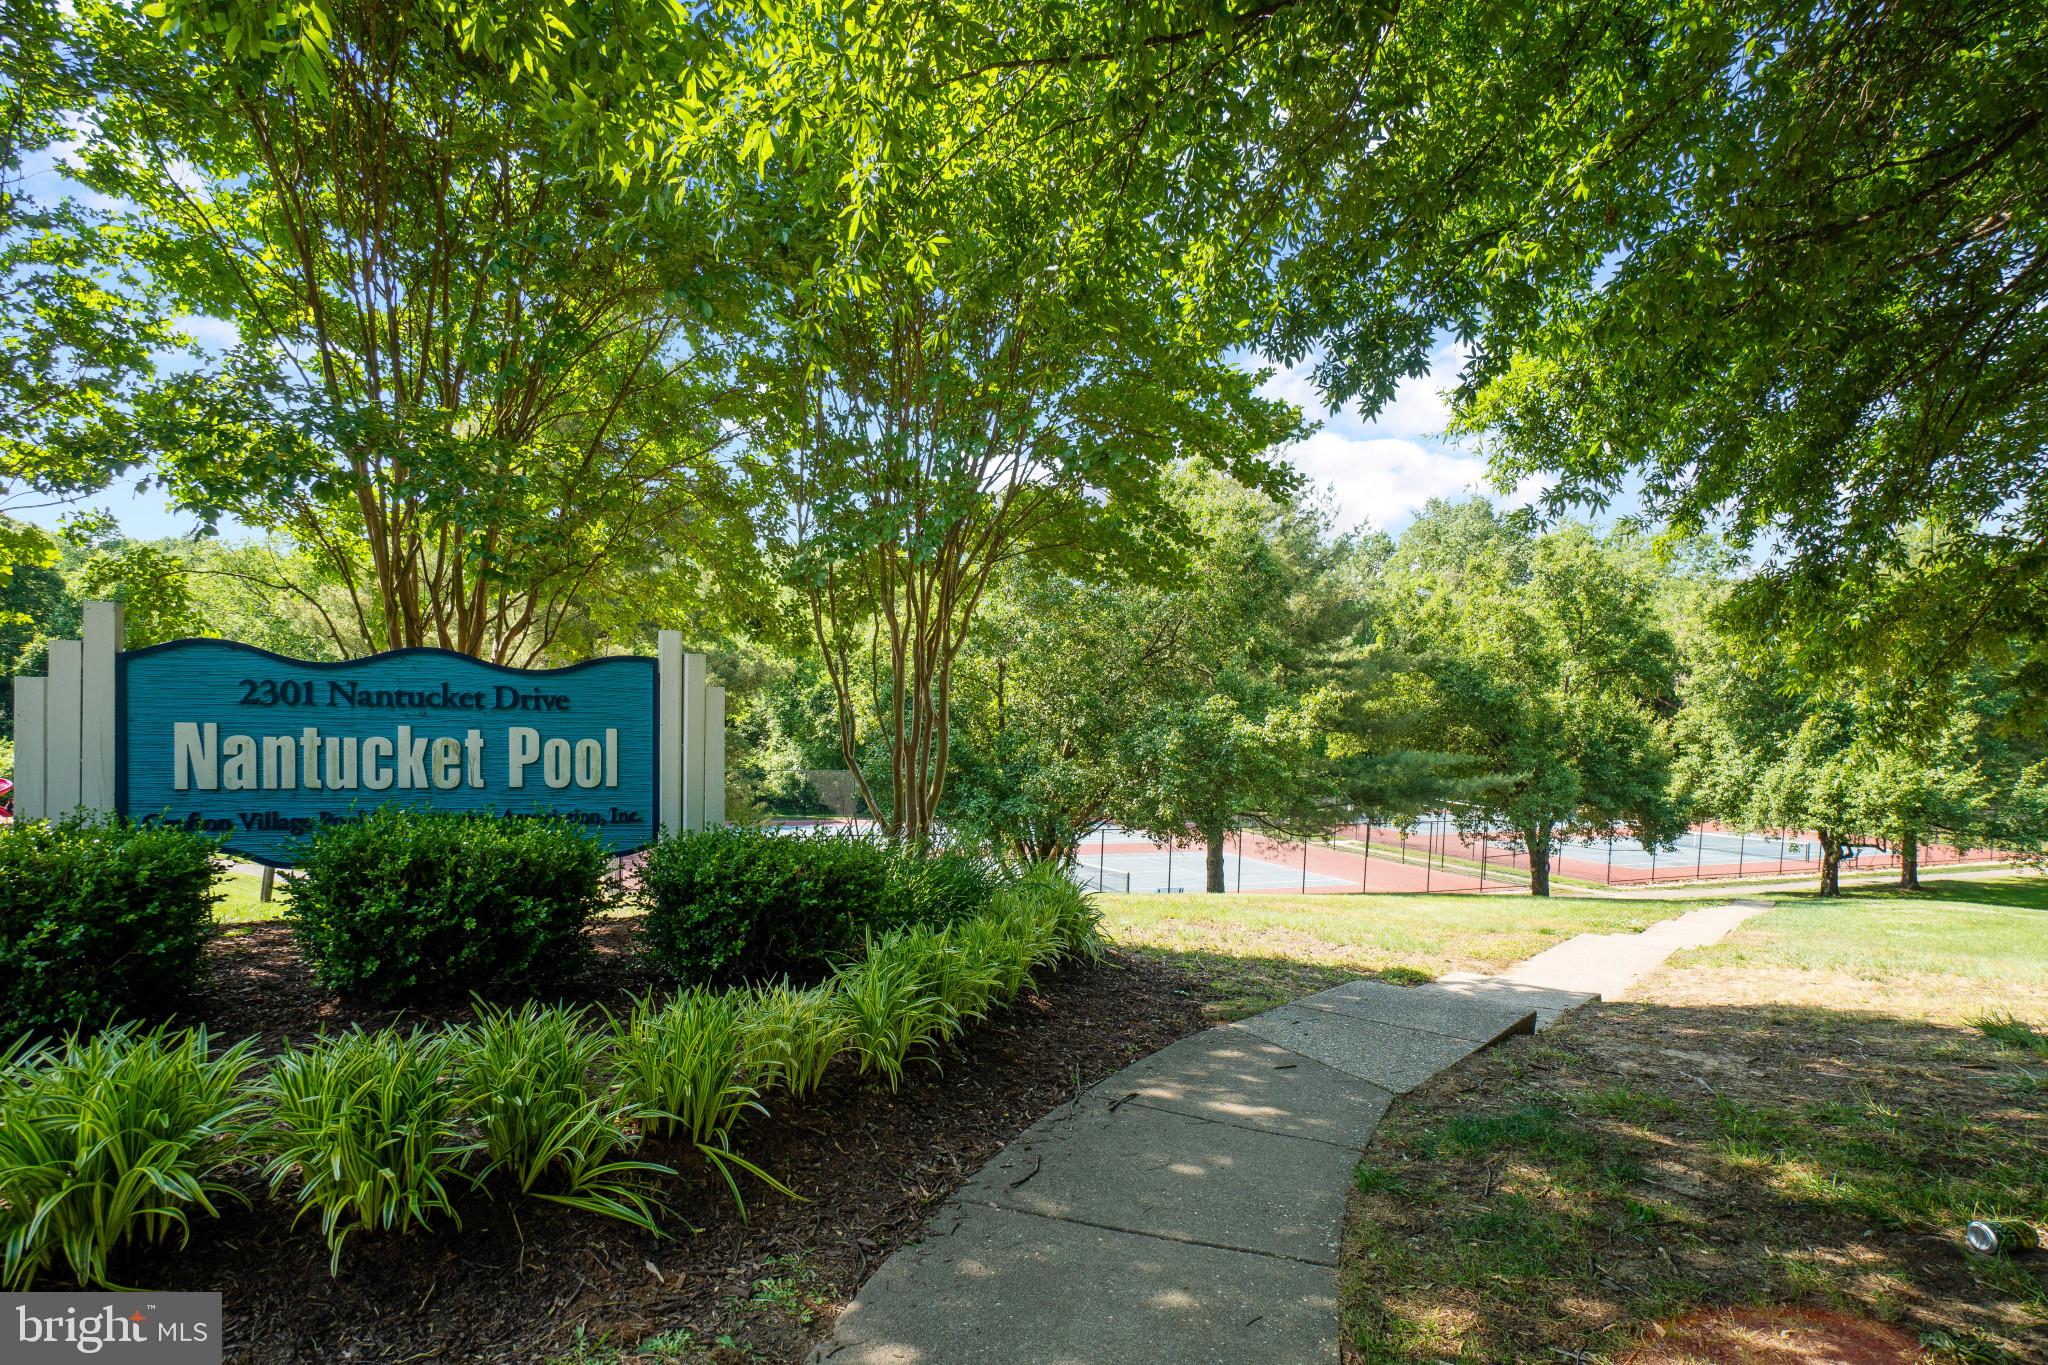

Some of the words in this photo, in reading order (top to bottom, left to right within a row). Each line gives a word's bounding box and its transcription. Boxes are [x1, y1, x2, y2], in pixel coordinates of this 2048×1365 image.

[239, 678, 317, 707] 2301
[326, 680, 486, 710] Nantucket
[493, 685, 570, 711] Drive
[173, 721, 485, 791] Nantucket
[508, 726, 619, 789] Pool
[238, 810, 314, 836] Village
[609, 807, 643, 824] Inc.
